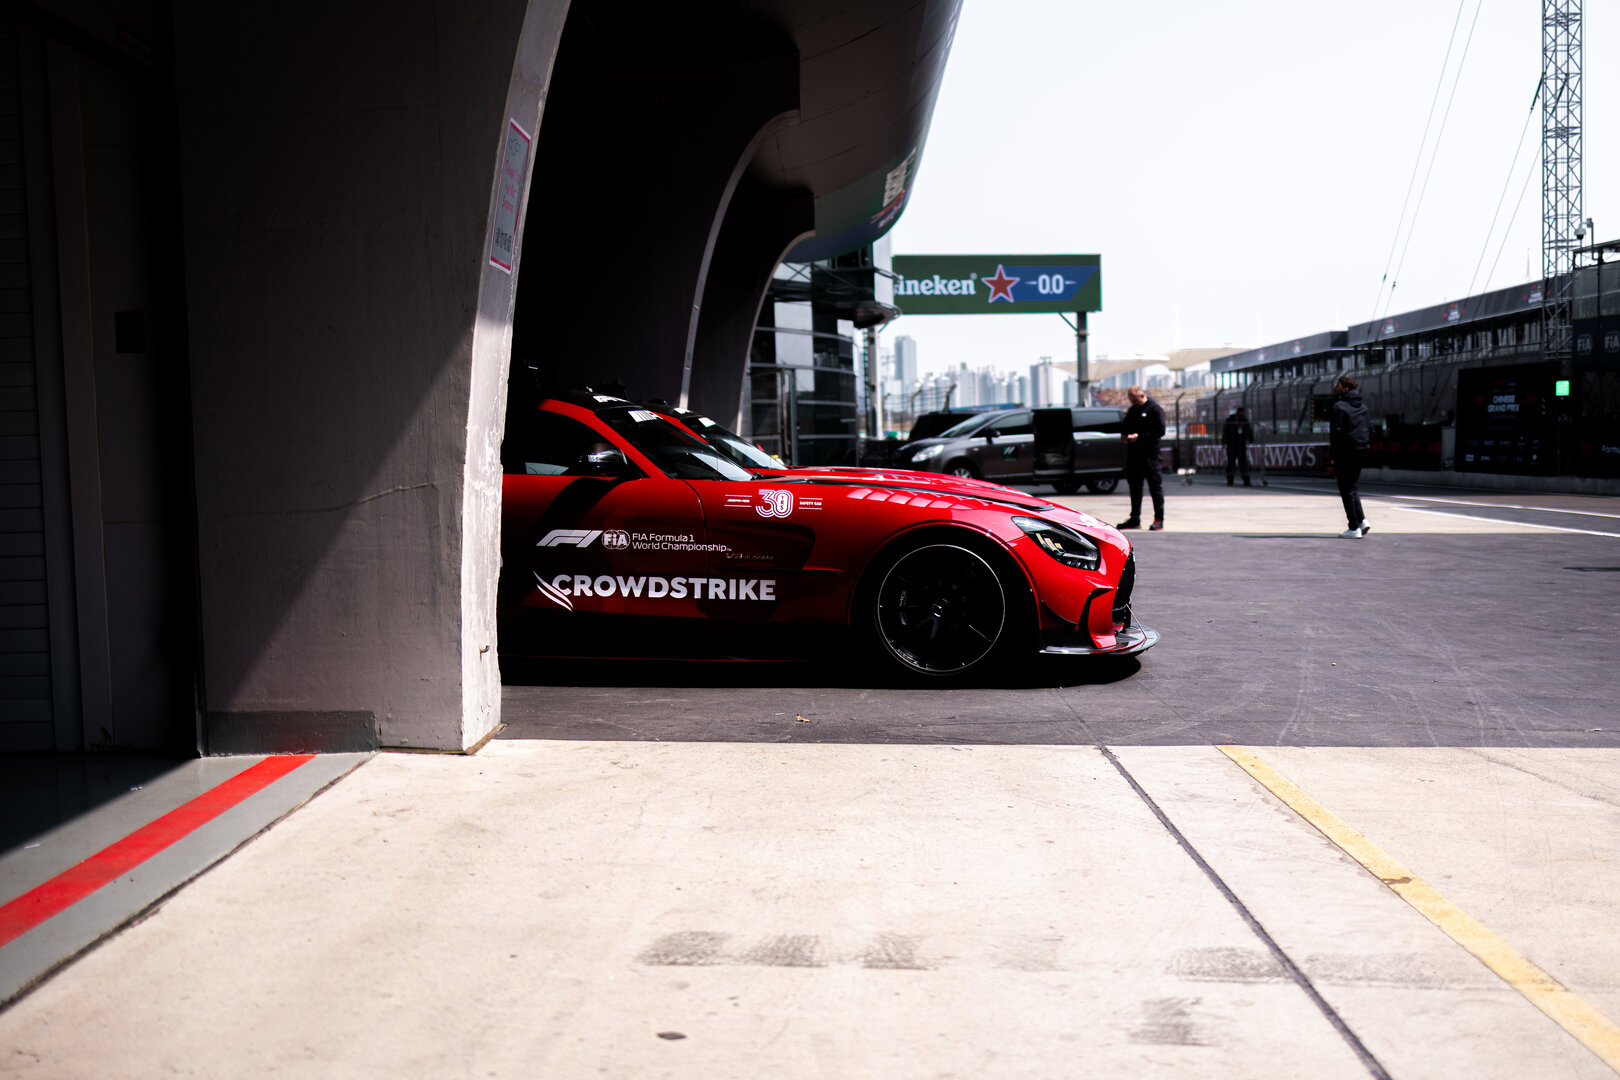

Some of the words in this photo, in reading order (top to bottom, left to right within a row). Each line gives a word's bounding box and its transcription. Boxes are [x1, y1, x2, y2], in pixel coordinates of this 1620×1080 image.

[894, 275, 976, 295] ineken
[756, 488, 793, 518] 30
[632, 533, 648, 541] FIA
[649, 533, 689, 542] Formula
[689, 534, 695, 543] 1
[632, 541, 660, 550] World
[551, 574, 776, 601] CROWDSTRIKE
